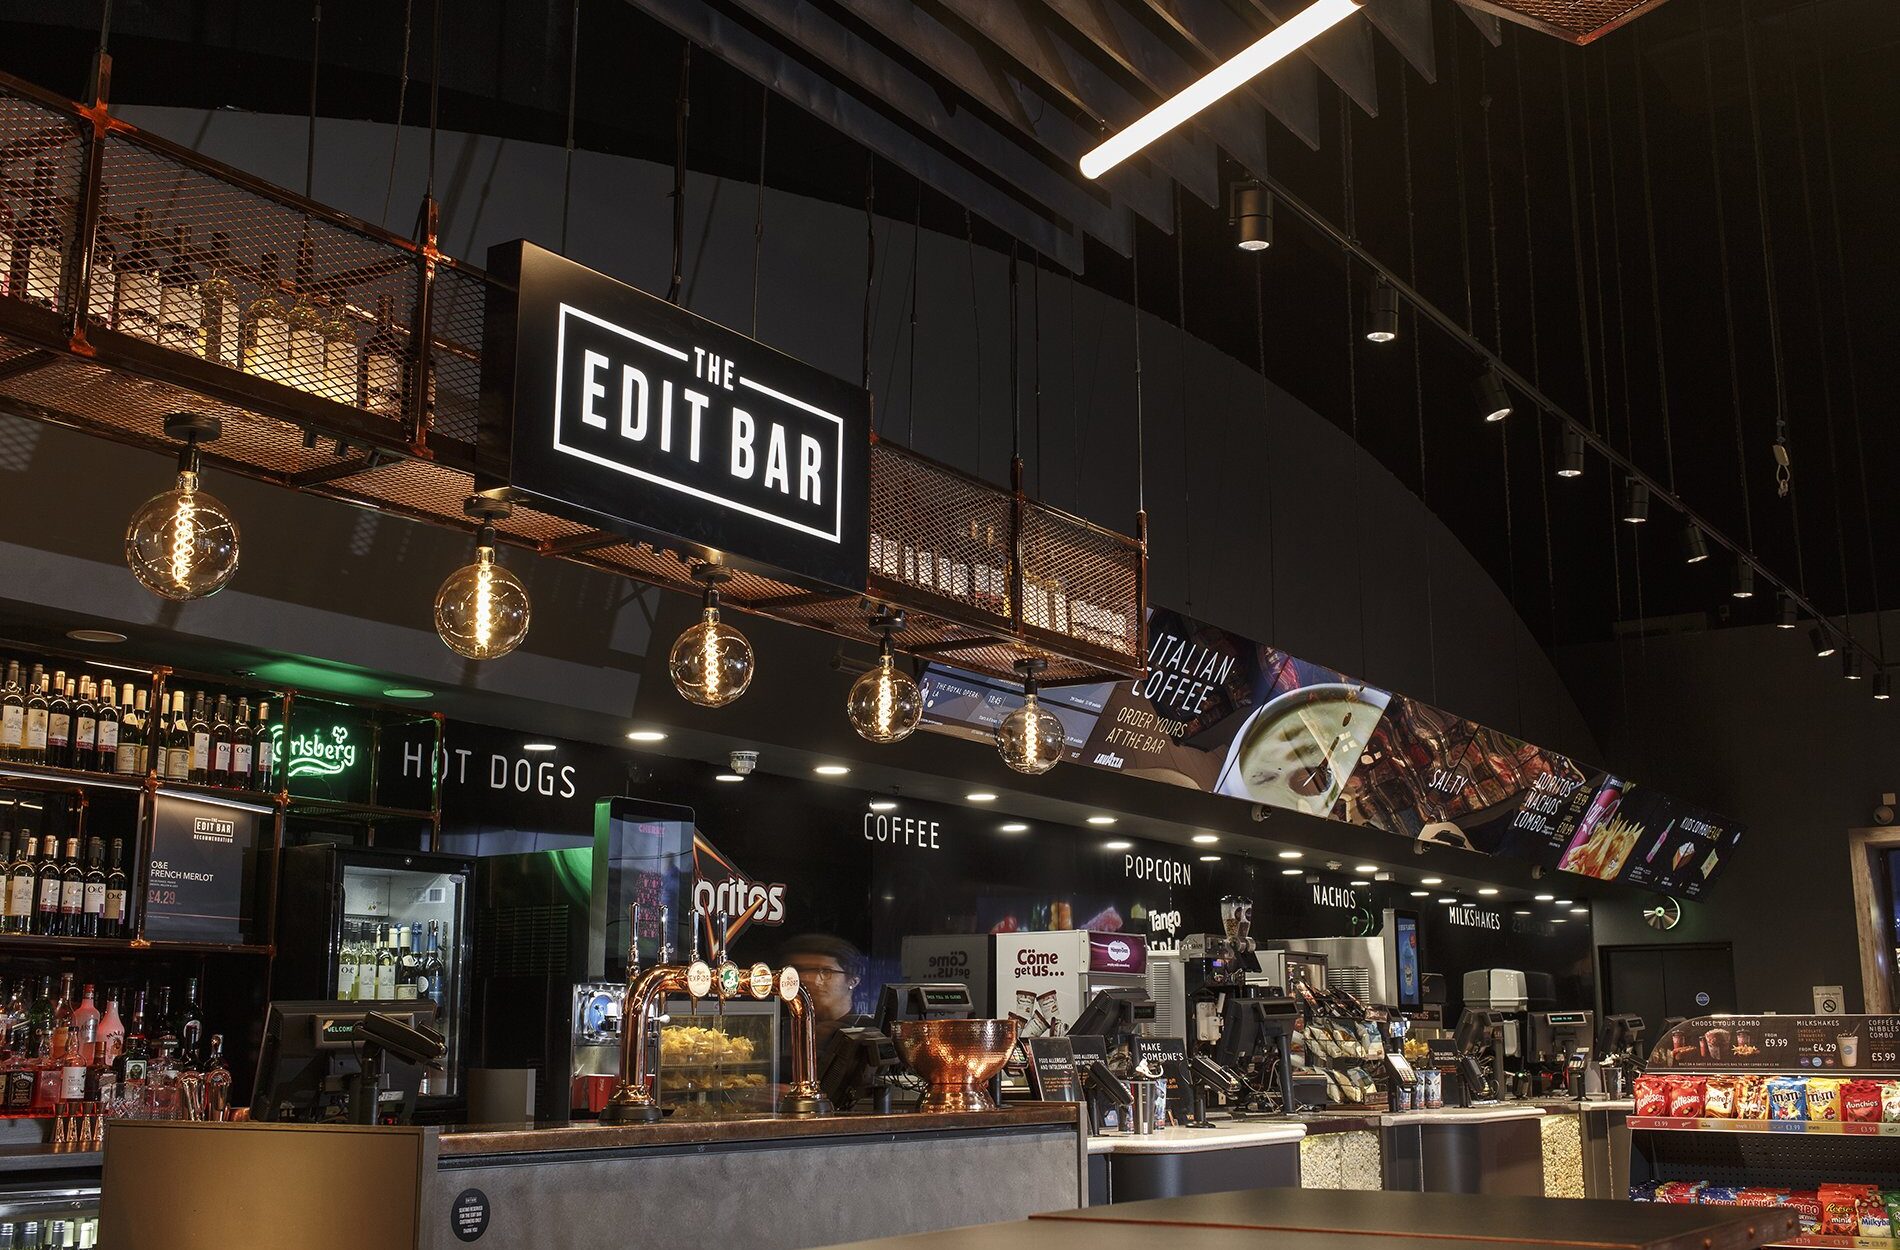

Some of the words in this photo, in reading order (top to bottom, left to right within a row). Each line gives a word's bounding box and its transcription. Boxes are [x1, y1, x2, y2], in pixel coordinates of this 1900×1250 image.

[694, 346, 735, 391] THE
[582, 349, 709, 464] EDIT
[731, 407, 822, 506] BAR
[1148, 633, 1235, 685] ITALIAN
[1132, 666, 1214, 715] COFFEE
[1117, 706, 1154, 730] ORDER
[1153, 714, 1188, 738] YOURS
[1105, 727, 1124, 744] AT
[1122, 730, 1145, 750] THE
[1142, 736, 1167, 754] BAR
[403, 741, 472, 784] HOT
[490, 754, 576, 798] DOGS
[1429, 768, 1470, 795] SALTY
[1537, 772, 1575, 798] DORITOS
[196, 822, 215, 832] EDIT
[216, 823, 232, 834] BAR
[864, 813, 940, 849] COFFEE
[1514, 810, 1547, 832] COMBO
[150, 869, 182, 879] FRENCH
[182, 872, 214, 882] MERLOT
[151, 860, 168, 870] O&E
[1125, 854, 1192, 886] POPCORN
[148, 889, 176, 904] £4.29
[693, 877, 787, 924] oritos
[1313, 884, 1356, 910] NACHOS
[1148, 910, 1182, 937] Tango
[1449, 906, 1501, 930] MILKSHAKES
[1016, 949, 1058, 965] Cöme
[1014, 966, 1030, 978] get
[1140, 1042, 1161, 1051] MAKE
[1765, 1038, 1788, 1047] £9.99
[1813, 1044, 1836, 1052] £4.29
[1142, 1052, 1184, 1060] SOMEONE'S
[1872, 1052, 1896, 1062] £5.99
[1781, 1202, 1820, 1215] RIBO
